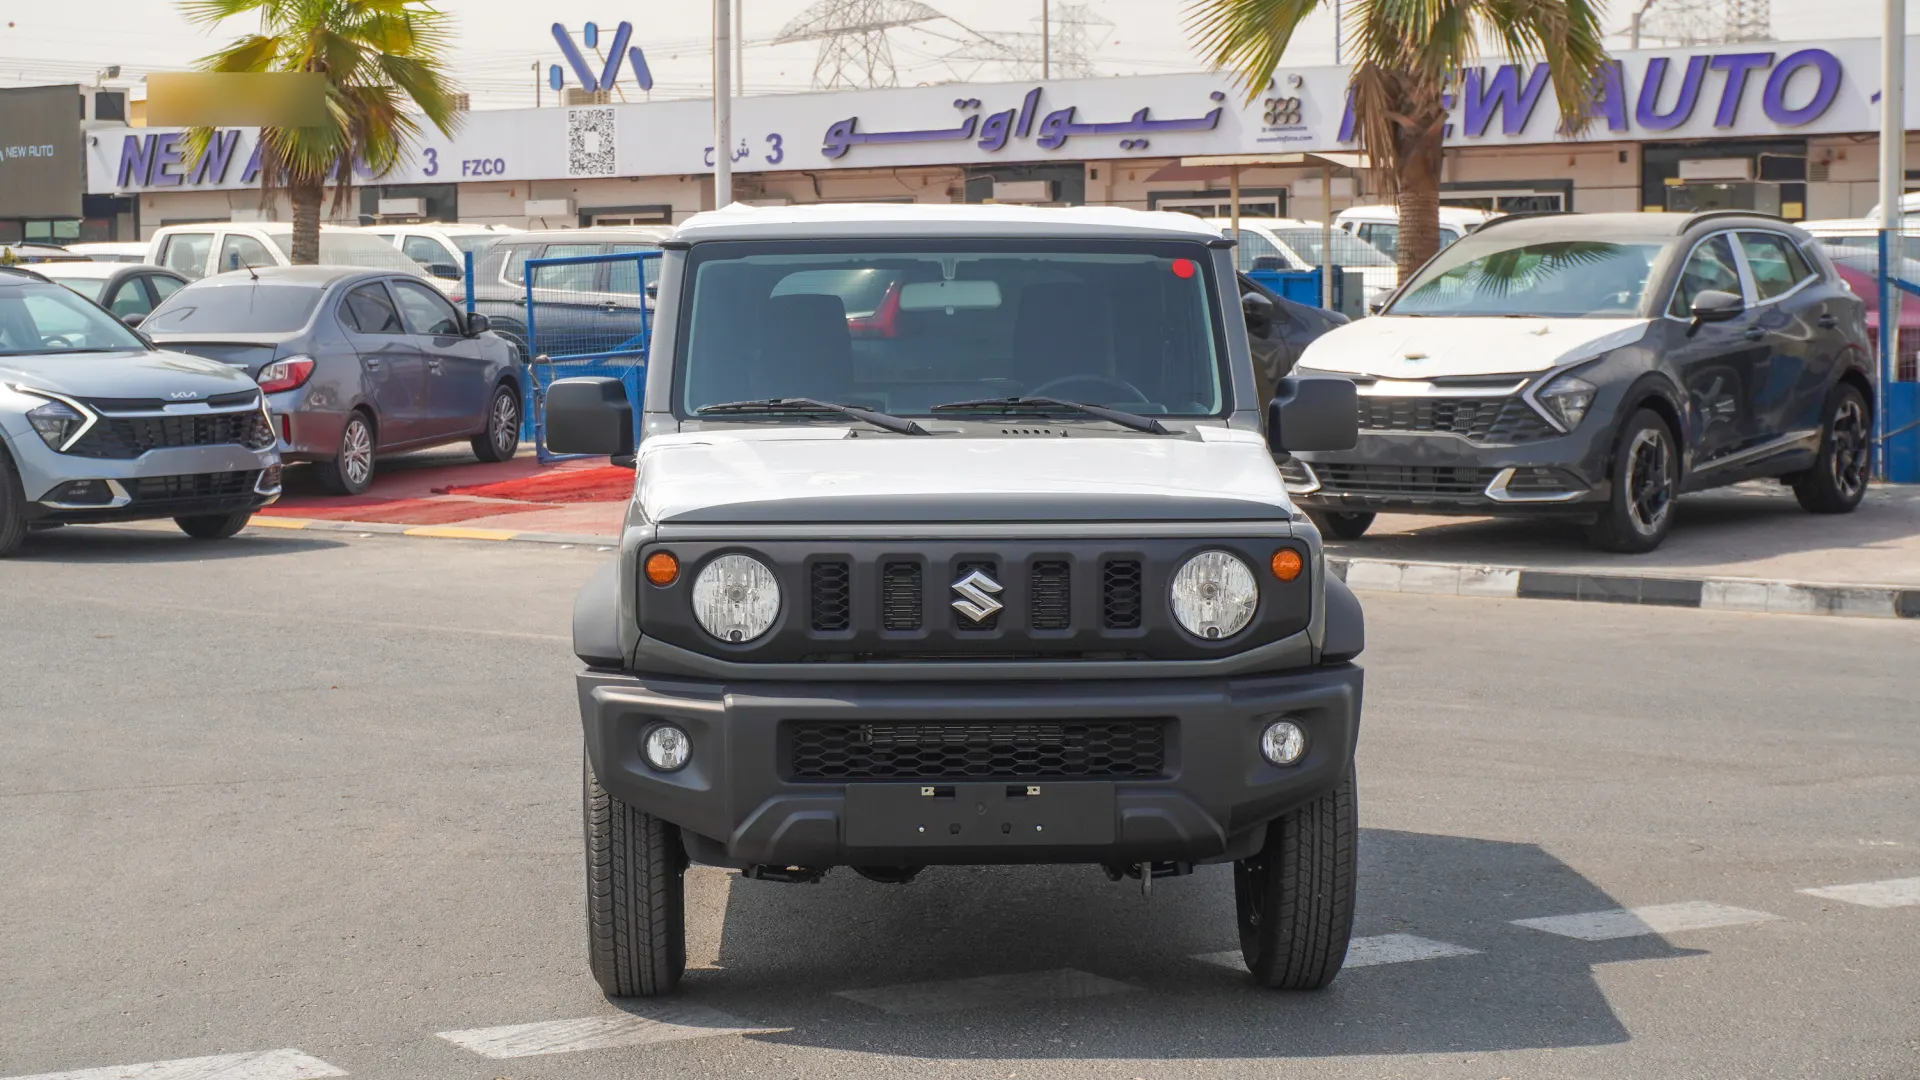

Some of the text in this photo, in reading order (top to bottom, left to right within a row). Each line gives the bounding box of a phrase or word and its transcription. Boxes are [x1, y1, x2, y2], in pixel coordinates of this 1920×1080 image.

[5, 145, 54, 159] NEW AUTO
[117, 129, 242, 188] NEW
[423, 147, 439, 177] 3
[462, 158, 506, 177] FZCO
[765, 132, 784, 165] 3
